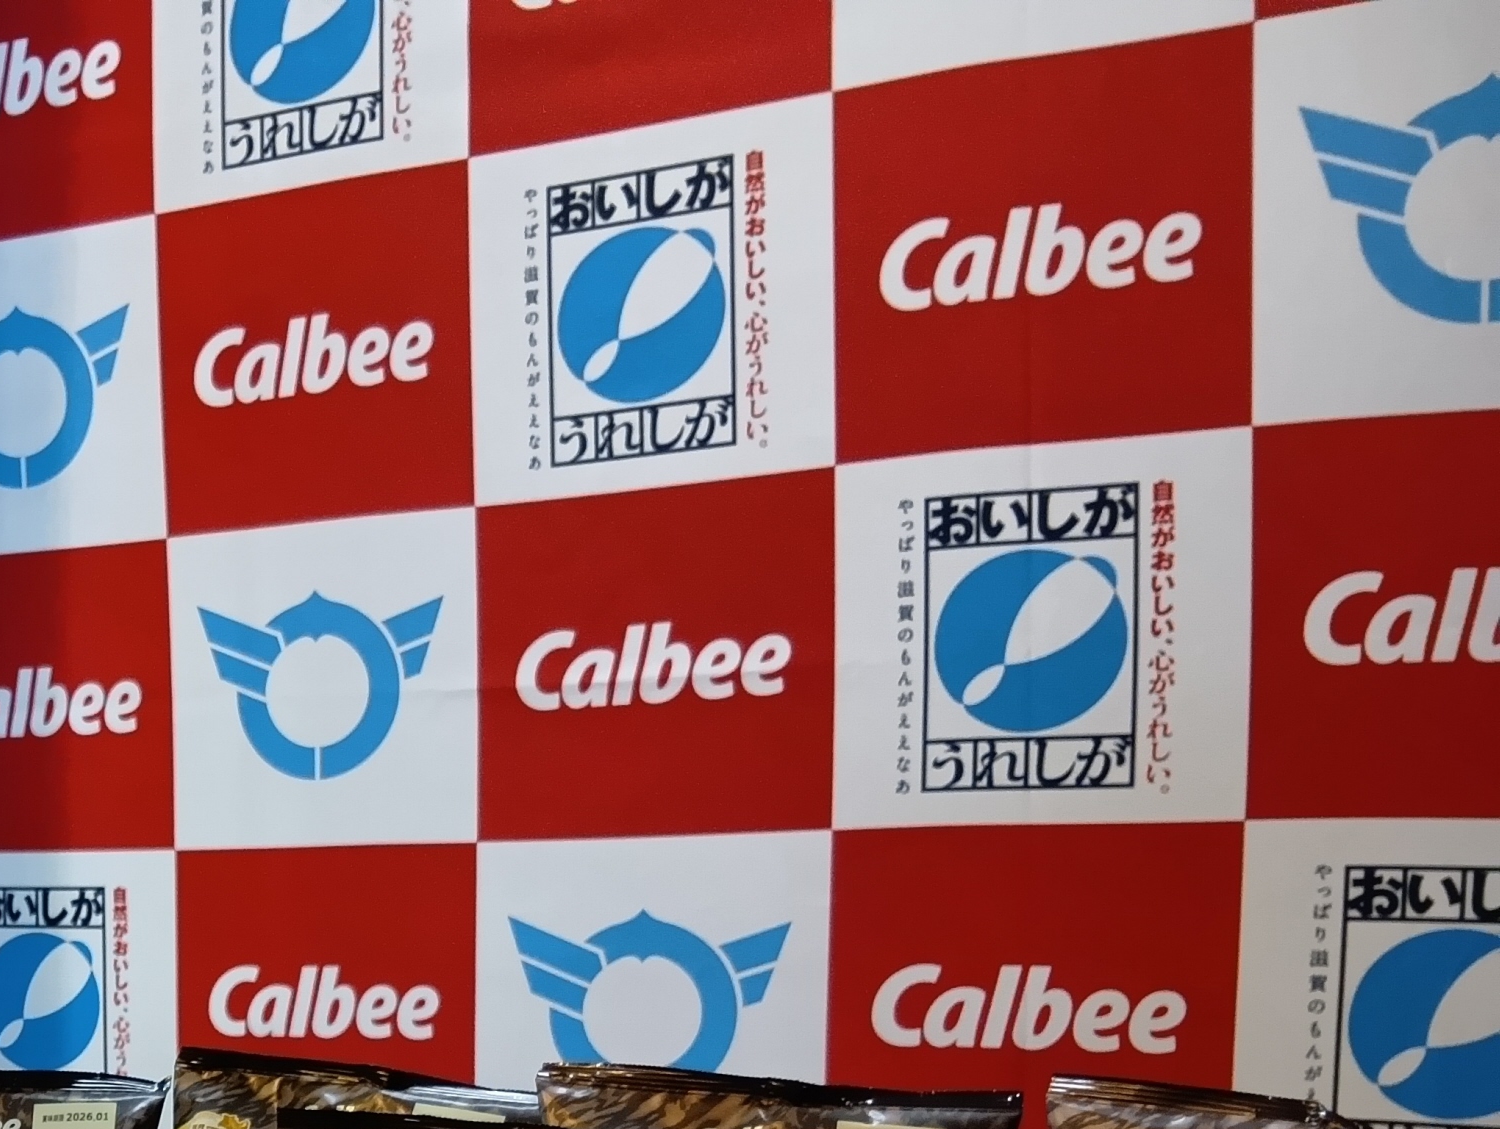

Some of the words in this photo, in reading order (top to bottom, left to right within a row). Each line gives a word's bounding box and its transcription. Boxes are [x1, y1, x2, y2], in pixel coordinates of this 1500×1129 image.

[229, 93, 382, 166] うれしが
[550, 156, 732, 231] おいしが
[879, 202, 1202, 312] Calbee
[194, 313, 434, 408] Calbee
[558, 398, 732, 465] うれしが
[928, 485, 1135, 545] おいしが
[515, 621, 792, 711] Calbee
[931, 737, 1132, 789] うれしが
[207, 964, 440, 1040] Calbee
[871, 963, 1187, 1054] Calbee
[66, 1111, 109, 1122] 2026.01
